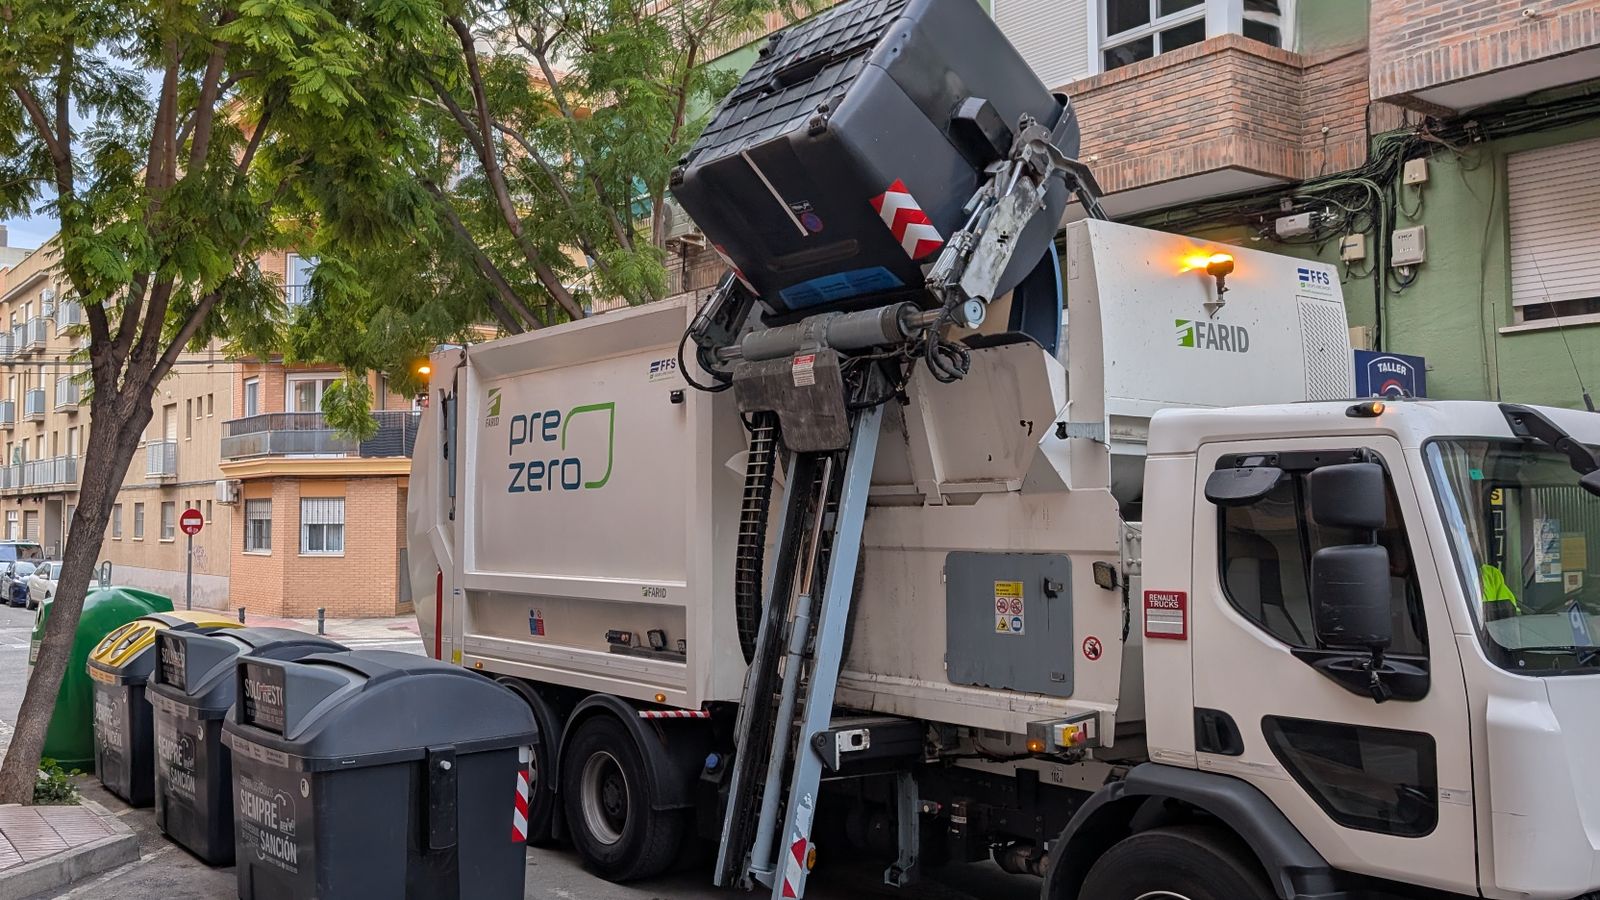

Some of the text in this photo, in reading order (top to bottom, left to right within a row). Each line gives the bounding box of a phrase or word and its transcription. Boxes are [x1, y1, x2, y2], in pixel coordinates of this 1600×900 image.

[1310, 270, 1330, 285] FFS
[1195, 321, 1249, 353] FARID
[660, 358, 676, 371] FFS
[1377, 362, 1407, 376] TALLER
[485, 417, 499, 428] FARID
[509, 410, 561, 456] pre
[508, 458, 581, 493] zero
[648, 587, 667, 598] FARID
[1149, 594, 1179, 602] RENAULT
[1149, 600, 1179, 608] TRUCKS
[245, 678, 261, 701] SOLO
[240, 788, 278, 830] SIEMPRE
[260, 830, 298, 865] SANCIÓN
